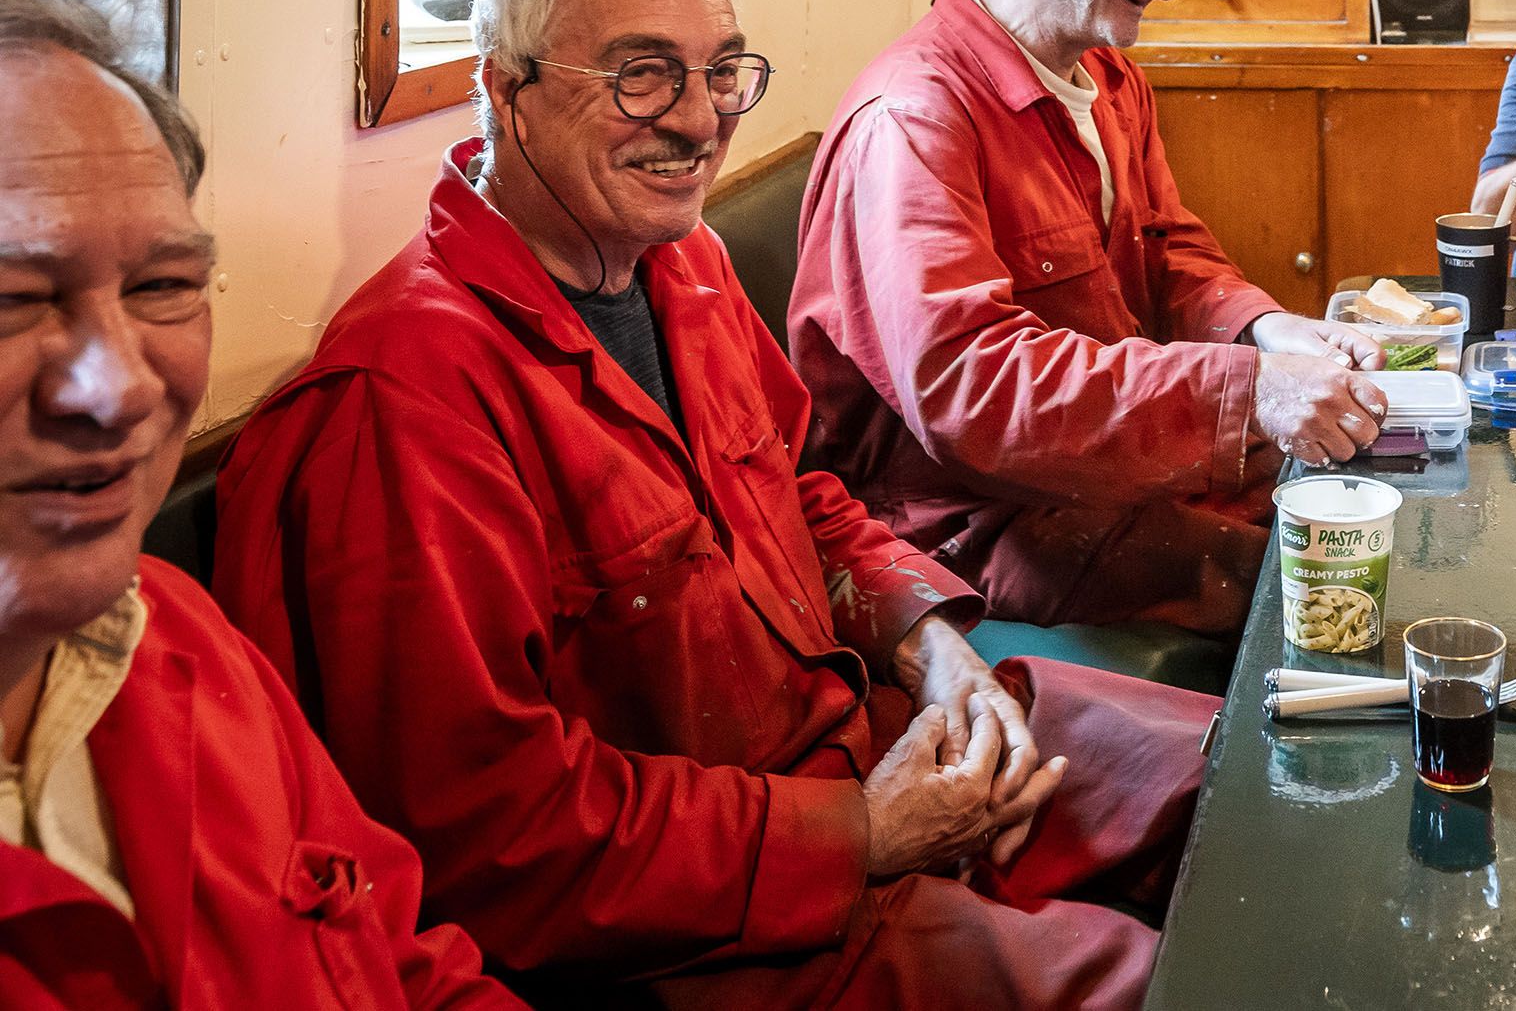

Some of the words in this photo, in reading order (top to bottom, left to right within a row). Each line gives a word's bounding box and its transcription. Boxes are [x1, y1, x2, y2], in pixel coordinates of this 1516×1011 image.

[1281, 525, 1309, 546] Knorr
[1318, 529, 1366, 547] PASTA
[1324, 547, 1356, 558] SNACK
[1293, 567, 1335, 580] CREAMY
[1336, 566, 1370, 580] PESTO
